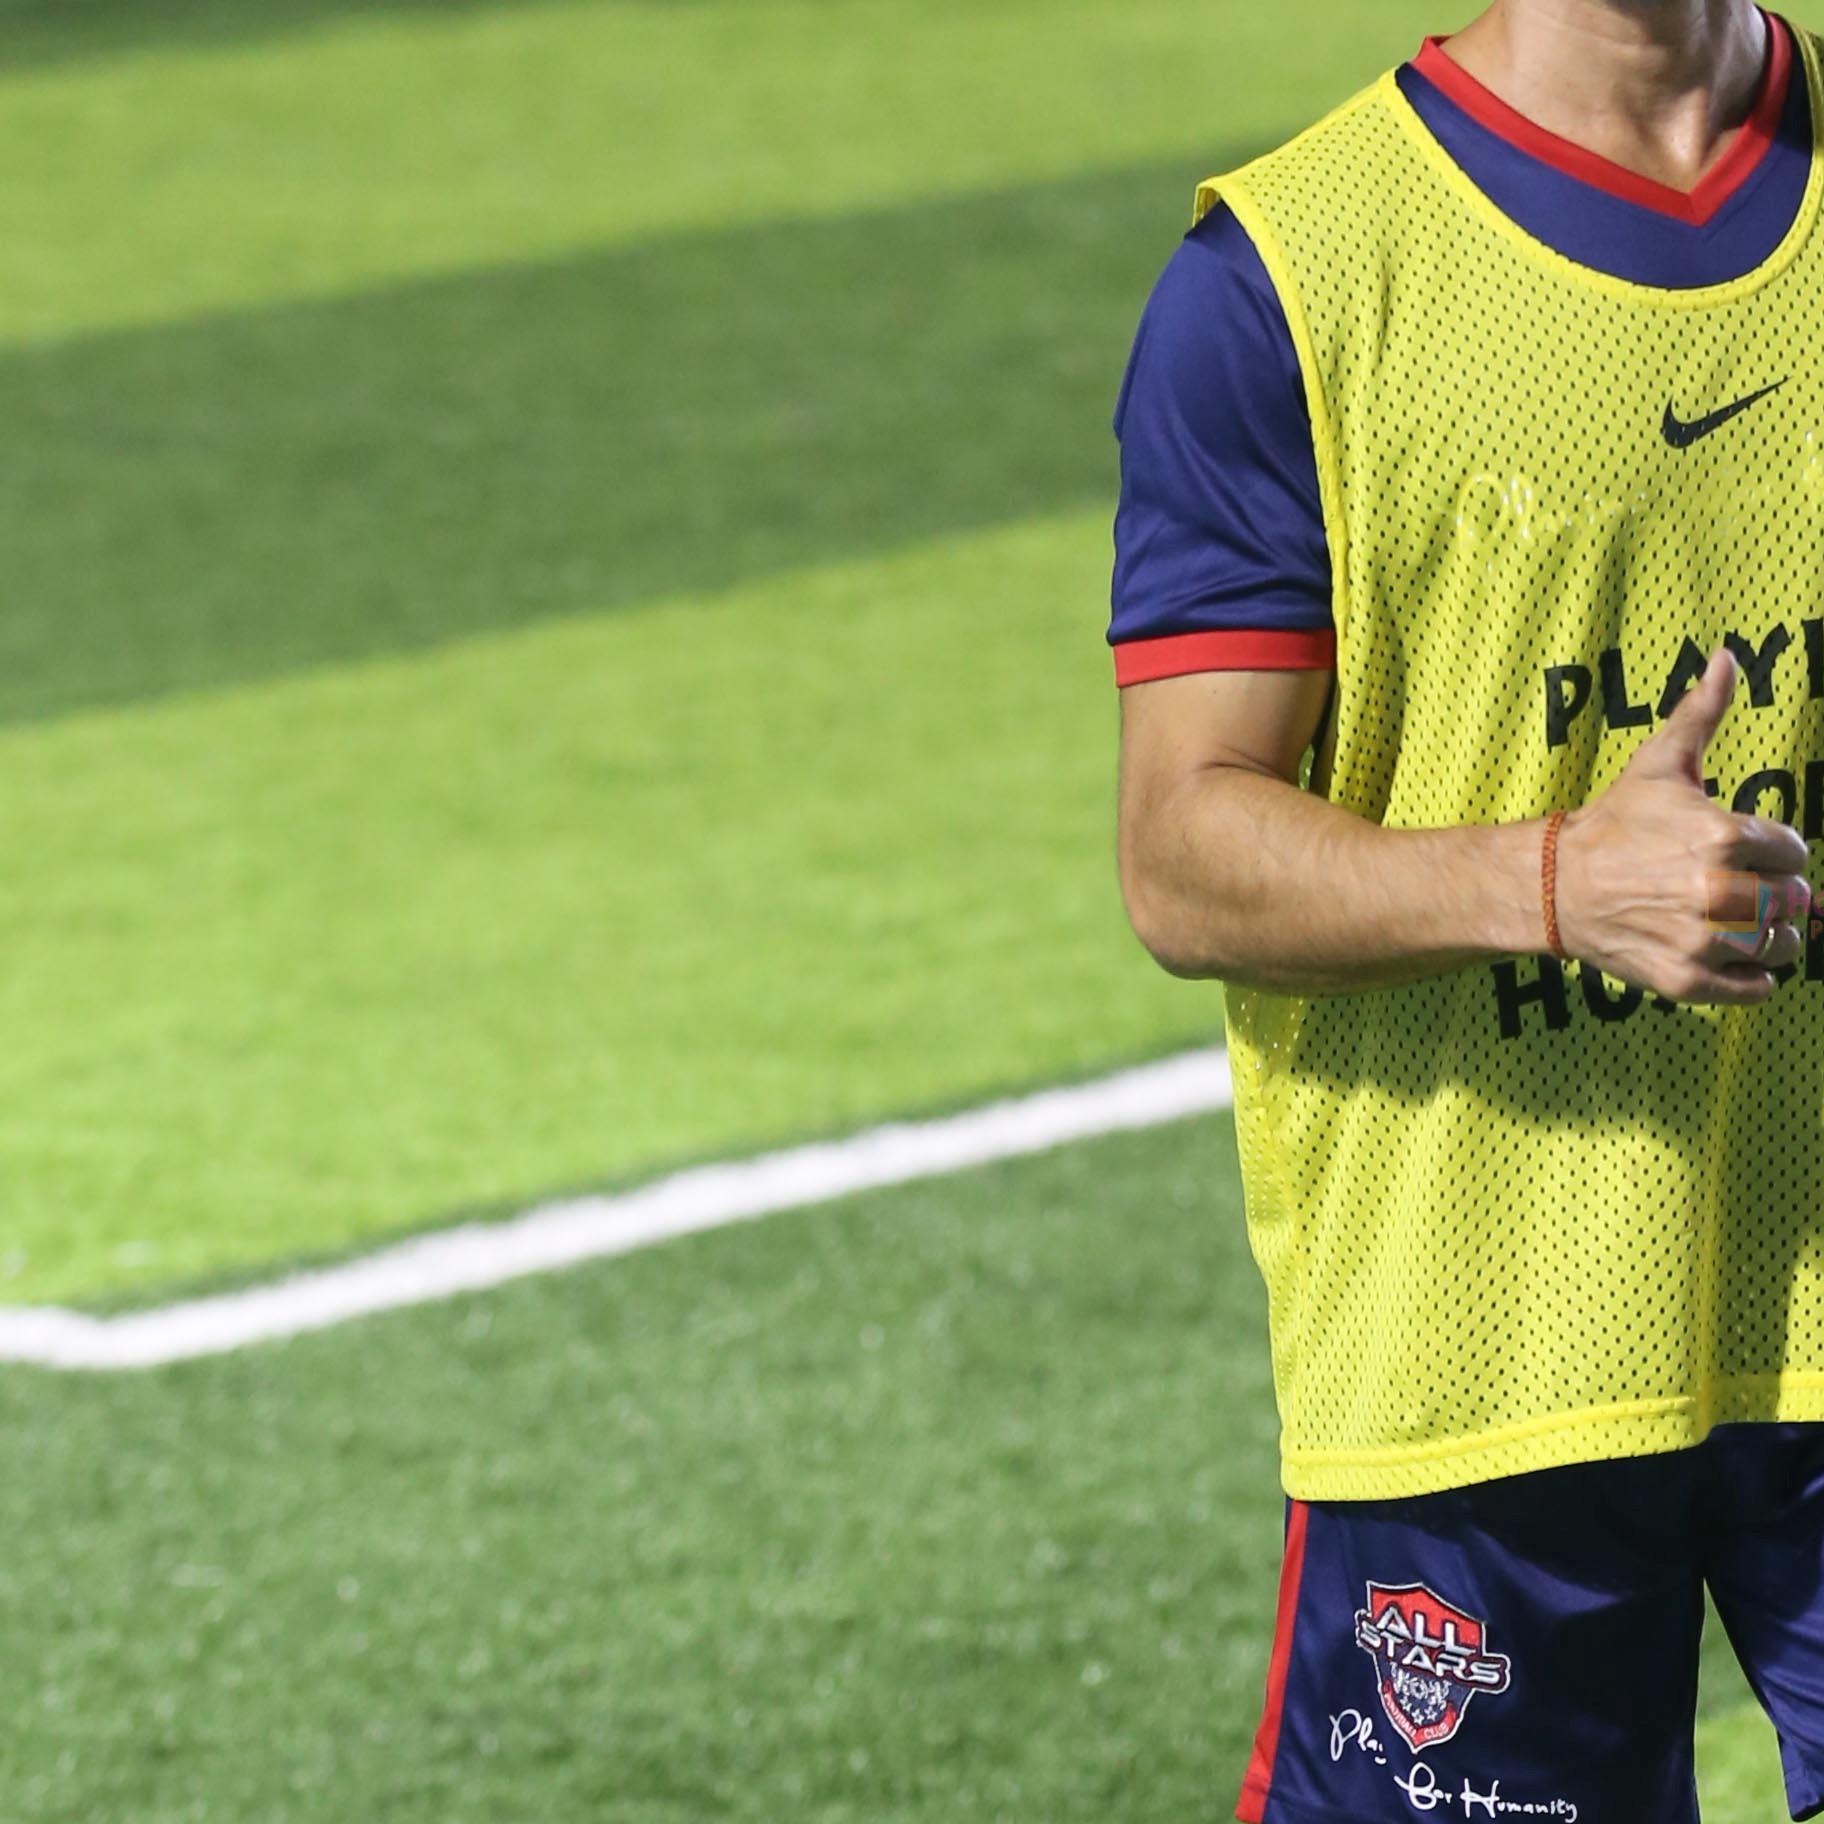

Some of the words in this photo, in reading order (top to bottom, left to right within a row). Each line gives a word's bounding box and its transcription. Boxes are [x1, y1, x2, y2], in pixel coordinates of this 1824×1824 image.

[1359, 1619, 1501, 1684] STARS
[1376, 1605, 1477, 1655] ALL
[1460, 1778, 1577, 1824] Humanity
